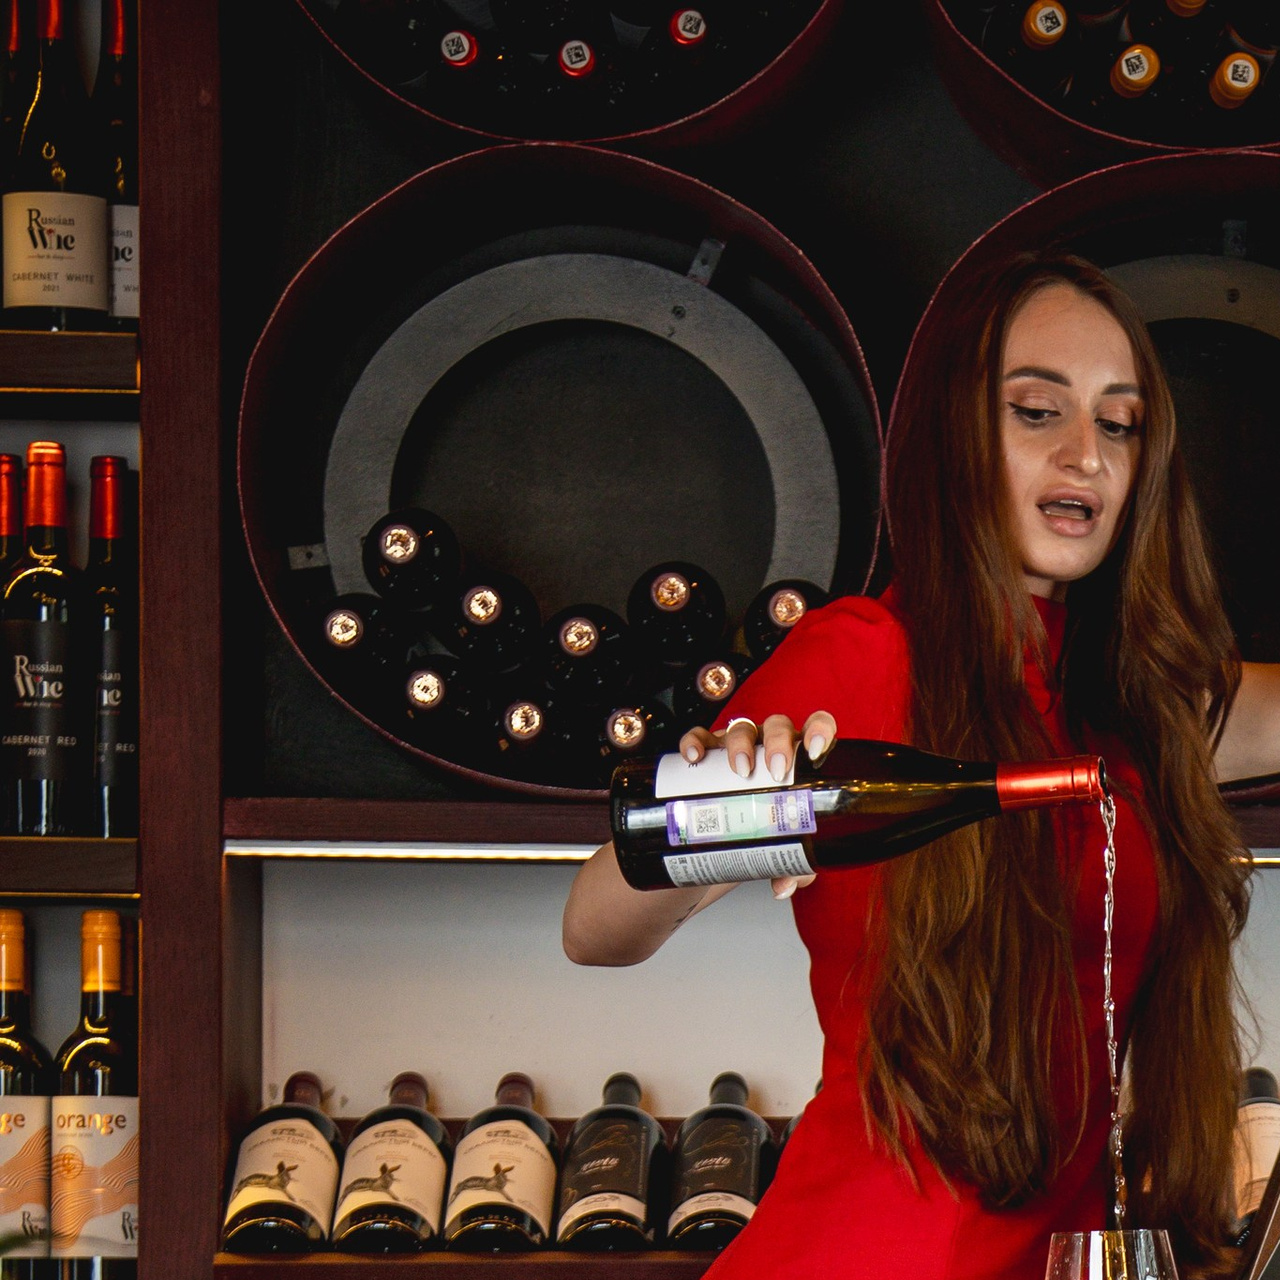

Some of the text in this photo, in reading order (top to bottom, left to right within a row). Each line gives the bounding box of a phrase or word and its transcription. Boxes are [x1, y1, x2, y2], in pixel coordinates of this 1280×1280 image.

[28, 208, 75, 228] Russian
[12, 271, 95, 284] CABERNET WHITE
[14, 654, 63, 676] Russian
[1, 735, 77, 746] CABERNET RED
[115, 743, 136, 753] RED
[56, 1112, 127, 1135] orange
